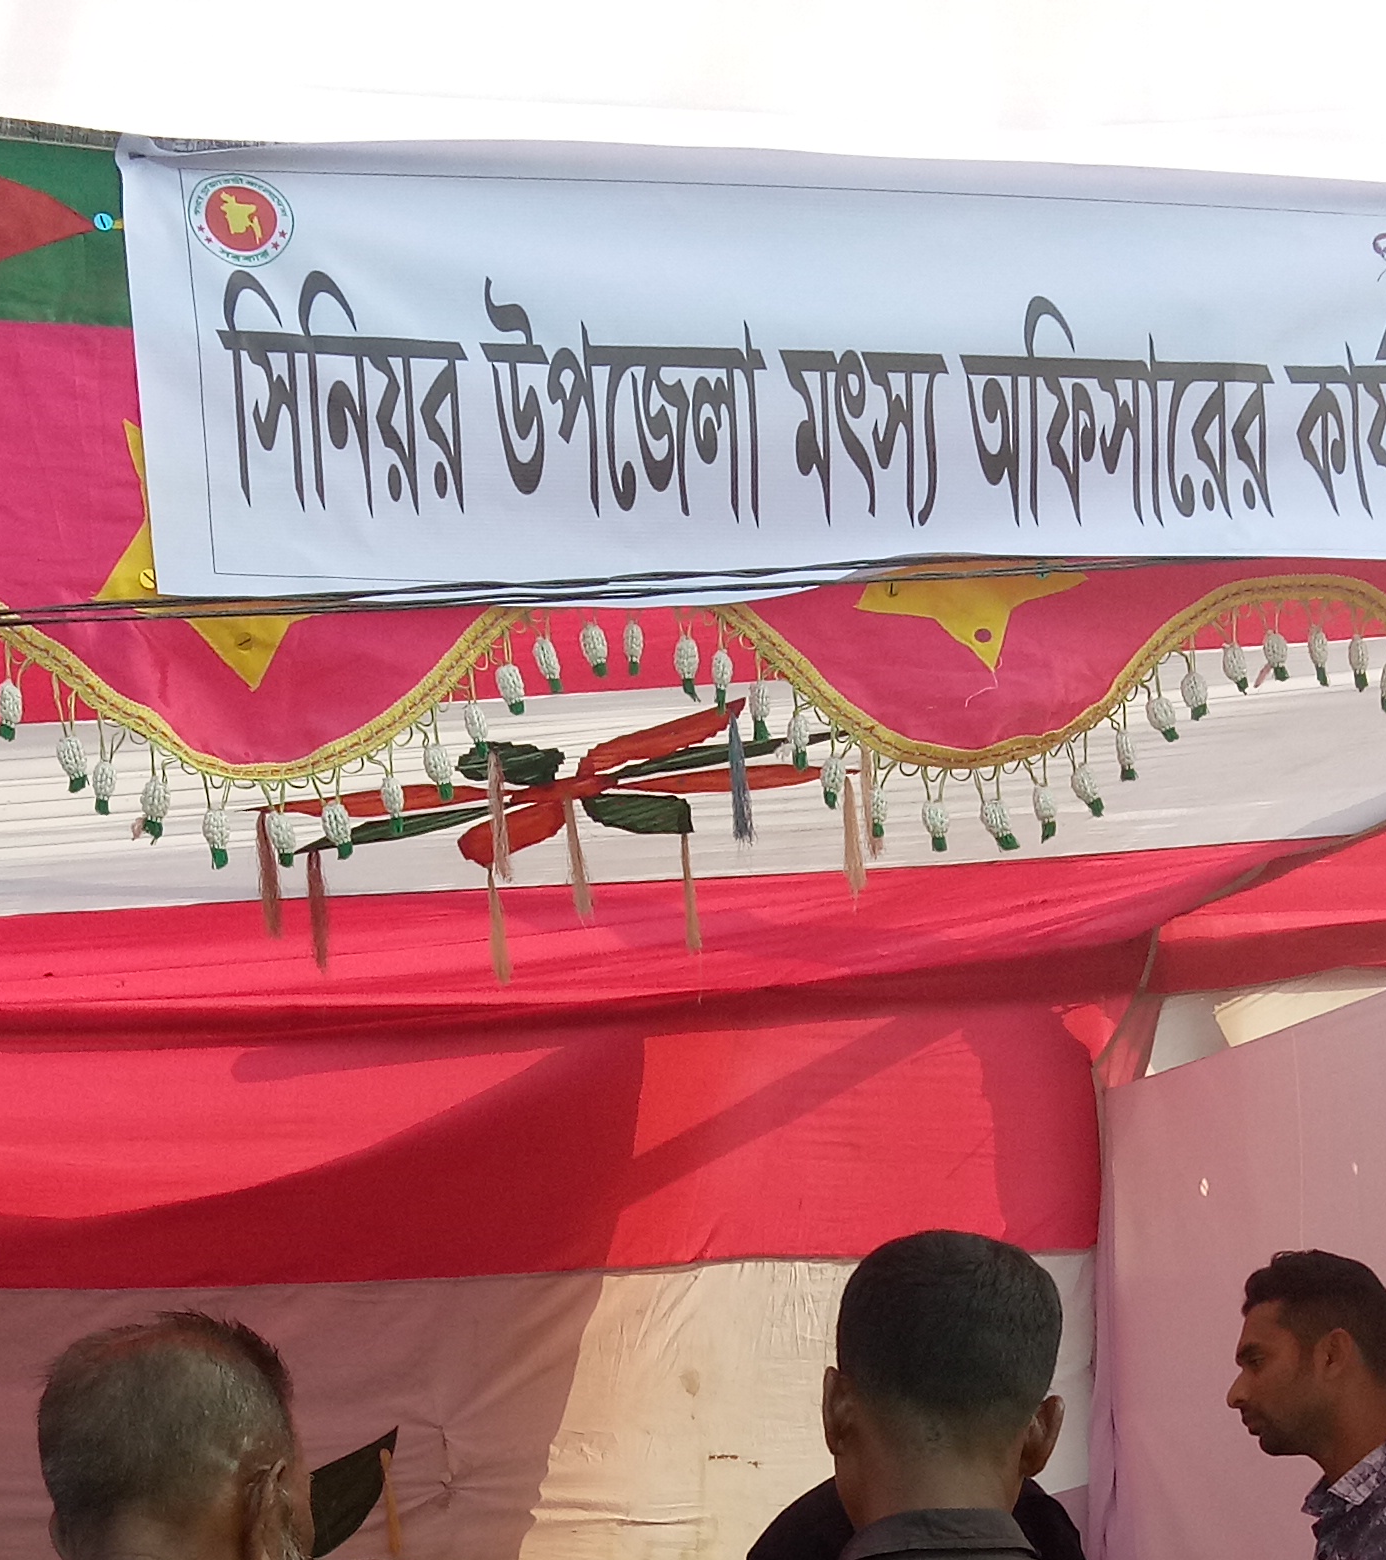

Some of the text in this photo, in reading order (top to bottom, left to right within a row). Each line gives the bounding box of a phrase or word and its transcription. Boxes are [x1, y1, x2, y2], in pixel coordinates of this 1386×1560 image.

[216, 270, 468, 517] সিনিয়র
[480, 276, 767, 528] উপজেলা
[778, 348, 949, 528] মৎস্য
[959, 296, 1275, 527] অফিসারের
